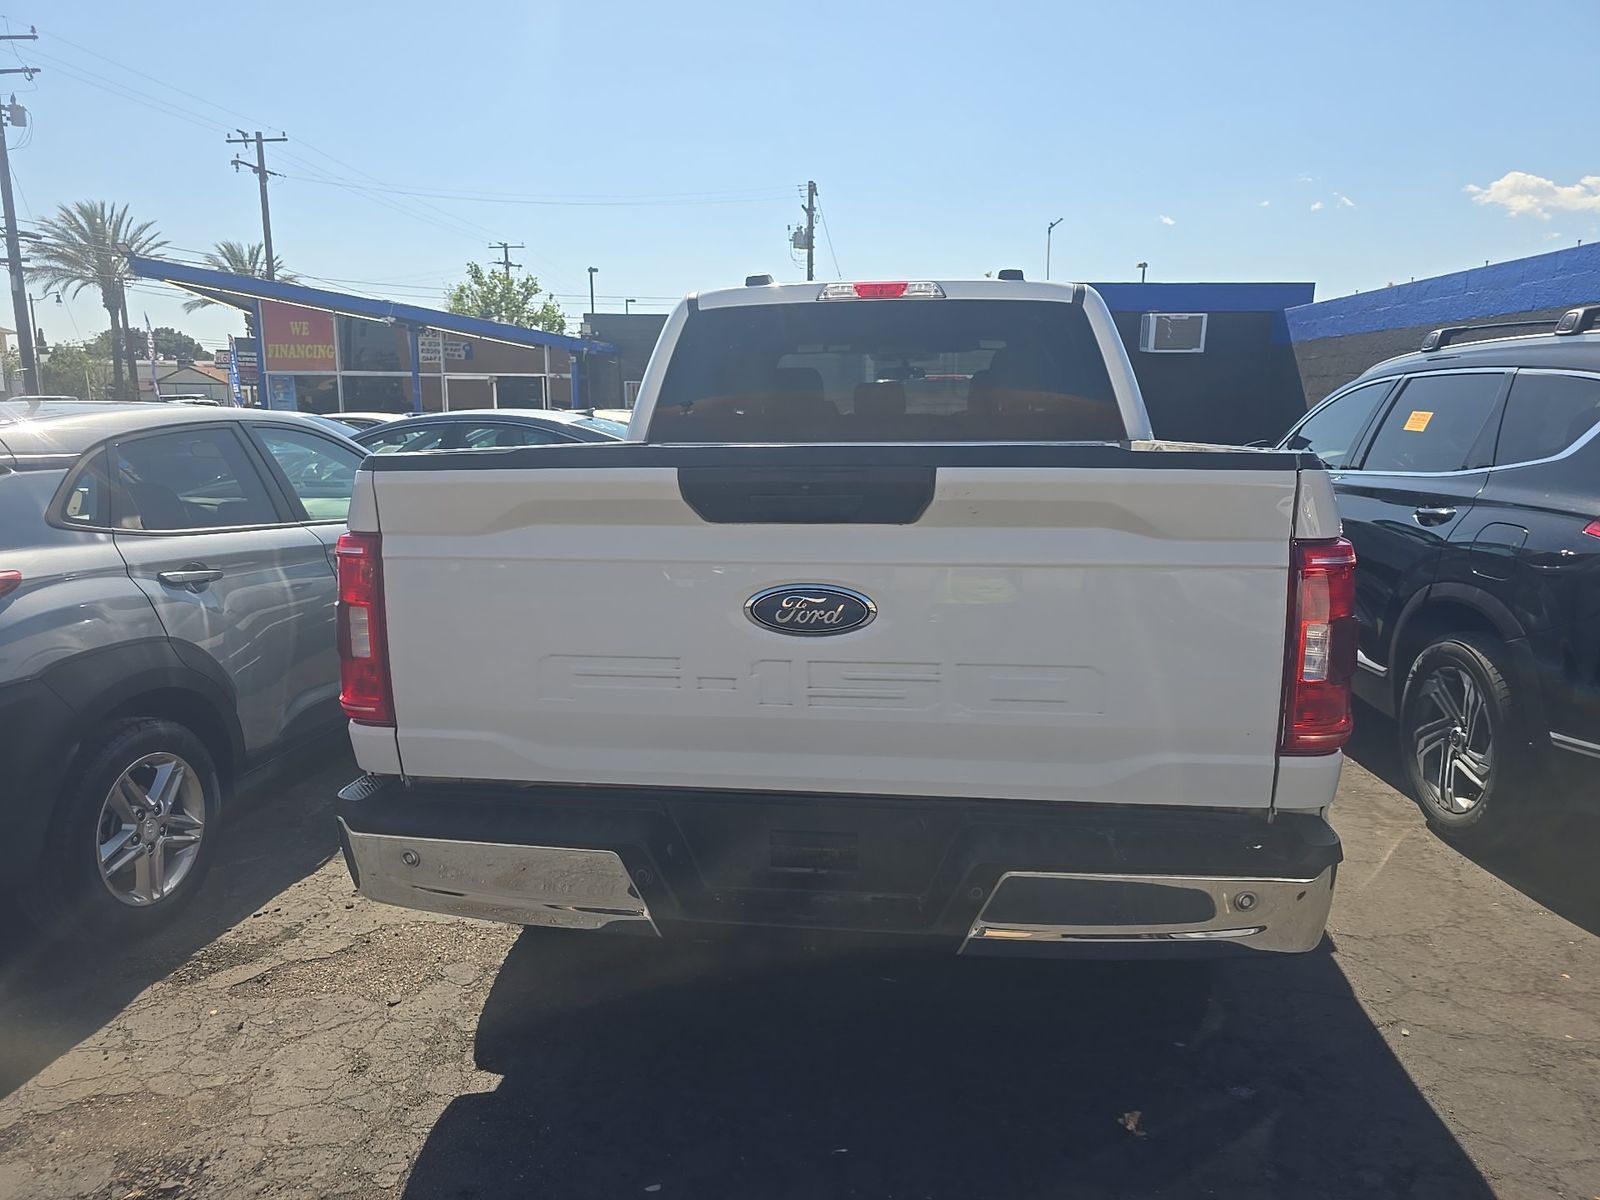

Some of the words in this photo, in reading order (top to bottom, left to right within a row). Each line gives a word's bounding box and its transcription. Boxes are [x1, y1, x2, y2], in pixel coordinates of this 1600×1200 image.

[289, 321, 310, 336] WE
[268, 343, 336, 359] FINANCING
[775, 595, 845, 624] Ford
[538, 653, 1105, 716] F-150
